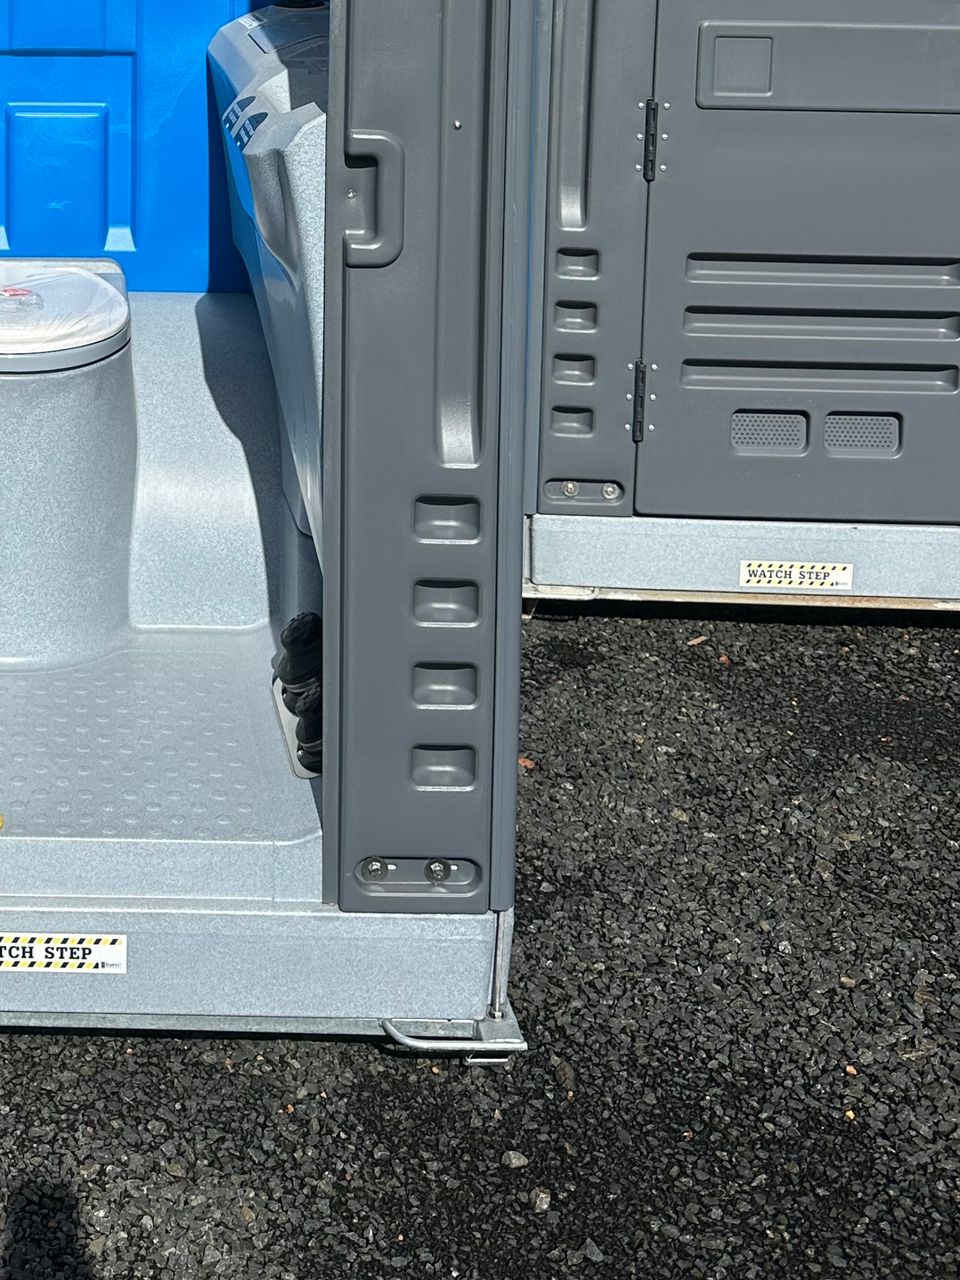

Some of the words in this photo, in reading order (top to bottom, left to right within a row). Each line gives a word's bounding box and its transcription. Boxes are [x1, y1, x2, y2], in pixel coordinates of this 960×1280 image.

[747, 569, 792, 579] WATCH
[798, 571, 830, 580] STEP
[44, 947, 91, 960] STEP
